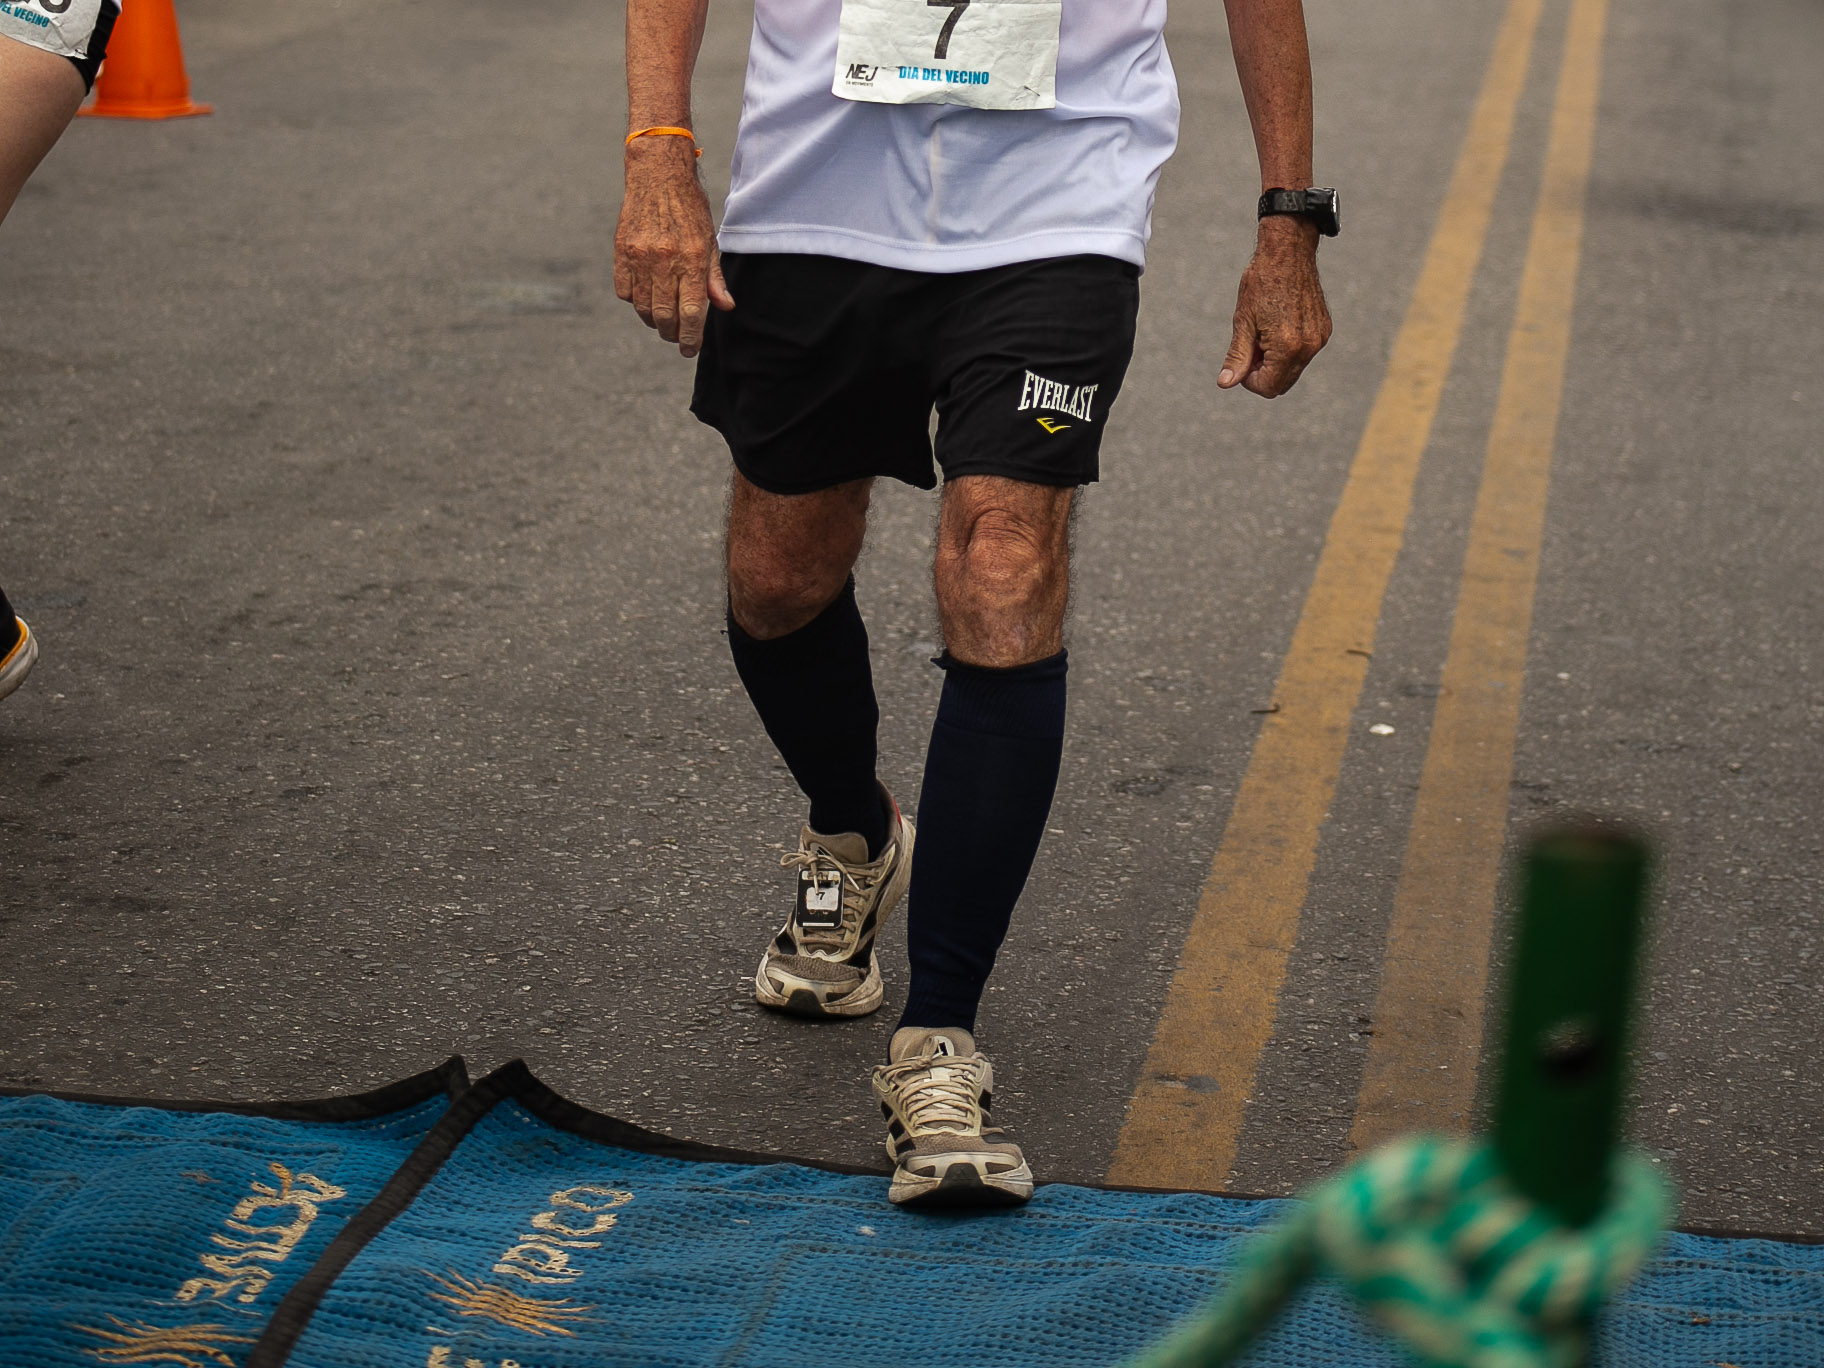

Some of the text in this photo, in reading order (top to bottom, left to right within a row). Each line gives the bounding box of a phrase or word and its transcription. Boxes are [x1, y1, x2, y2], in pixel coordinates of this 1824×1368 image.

[13, 6, 50, 28] VECINO
[845, 63, 879, 82] NEJ
[899, 65, 990, 85] DIA DEL VECINO
[1017, 369, 1099, 422] EVERLAST
[816, 891, 826, 901] 7
